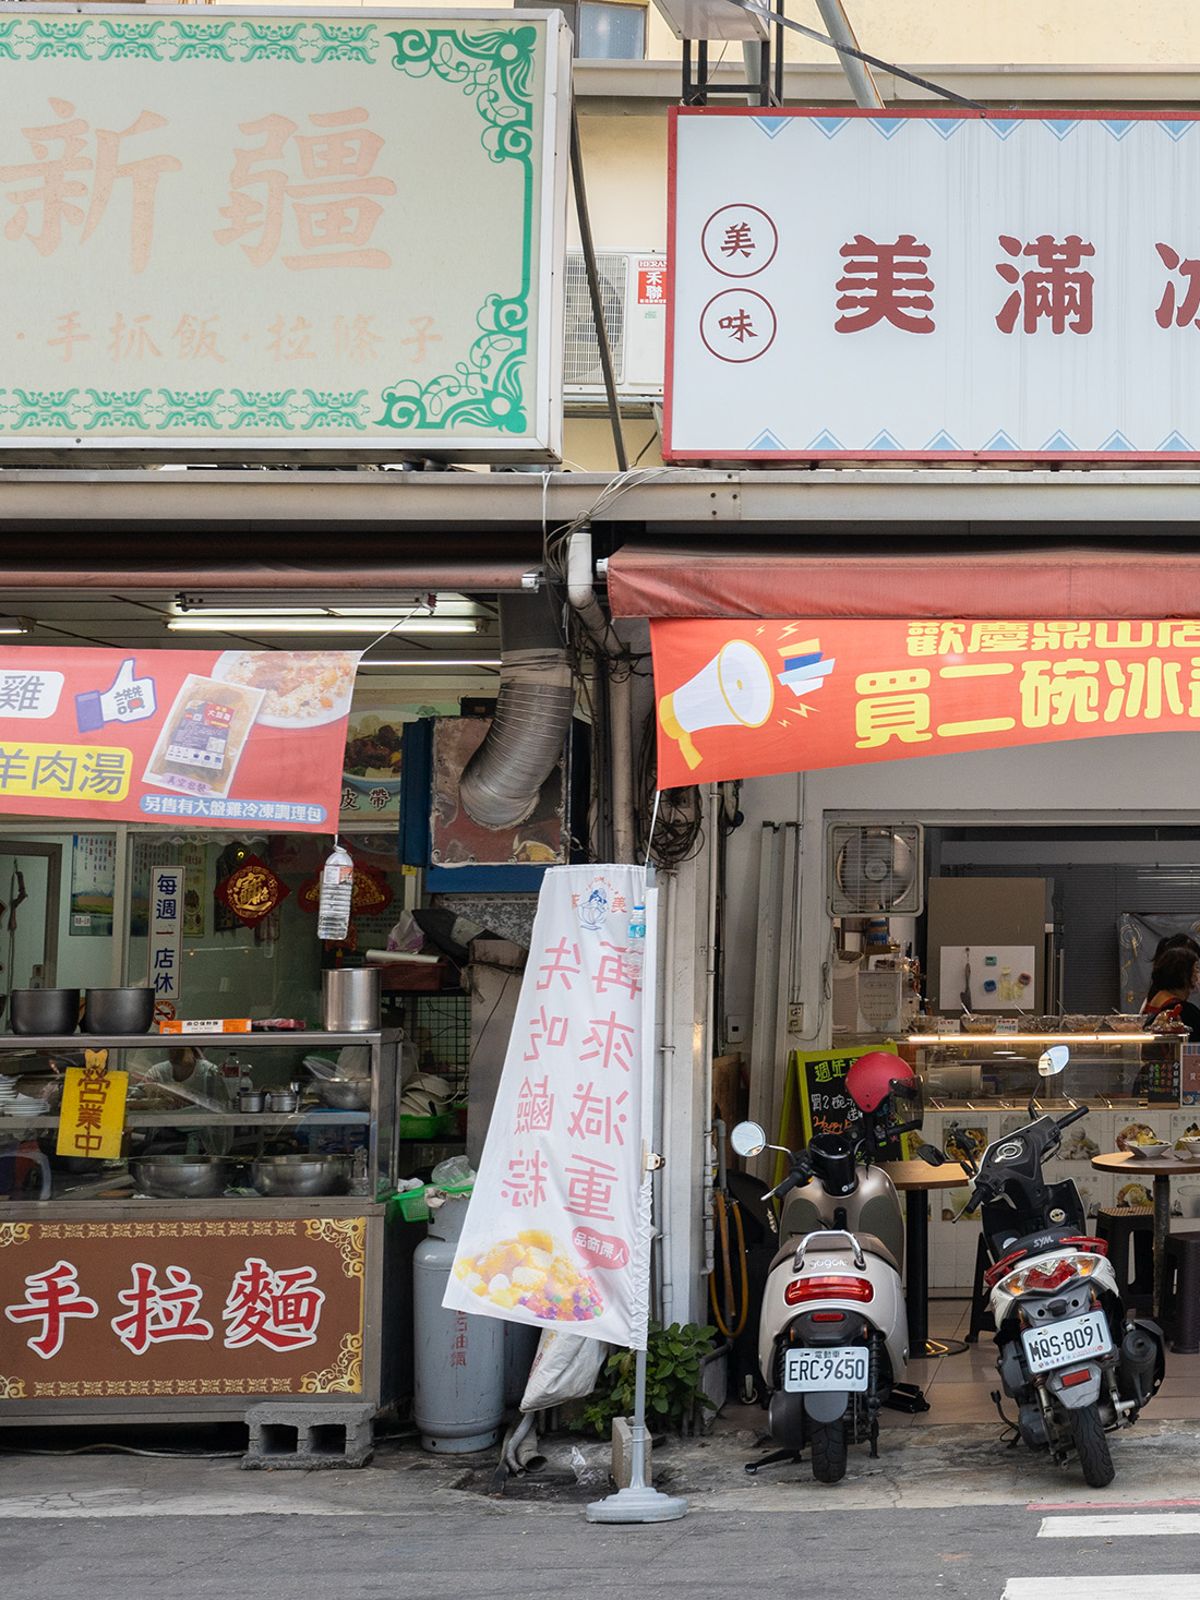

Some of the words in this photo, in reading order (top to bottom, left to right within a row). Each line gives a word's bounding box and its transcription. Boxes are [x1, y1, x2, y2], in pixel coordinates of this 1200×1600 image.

[0, 97, 397, 274] 新疆
[646, 271, 663, 299] 禾聯
[114, 685, 145, 715] 讚
[0, 748, 126, 795] 羊肉湯
[145, 796, 322, 823] 另售有大盤雞冷凍調理包
[154, 874, 178, 994] 每週一店休
[814, 1059, 857, 1082] 週年
[74, 1066, 111, 1158] 營業中
[1033, 1235, 1055, 1248] SYM
[5, 1257, 326, 1359] 手拉麵
